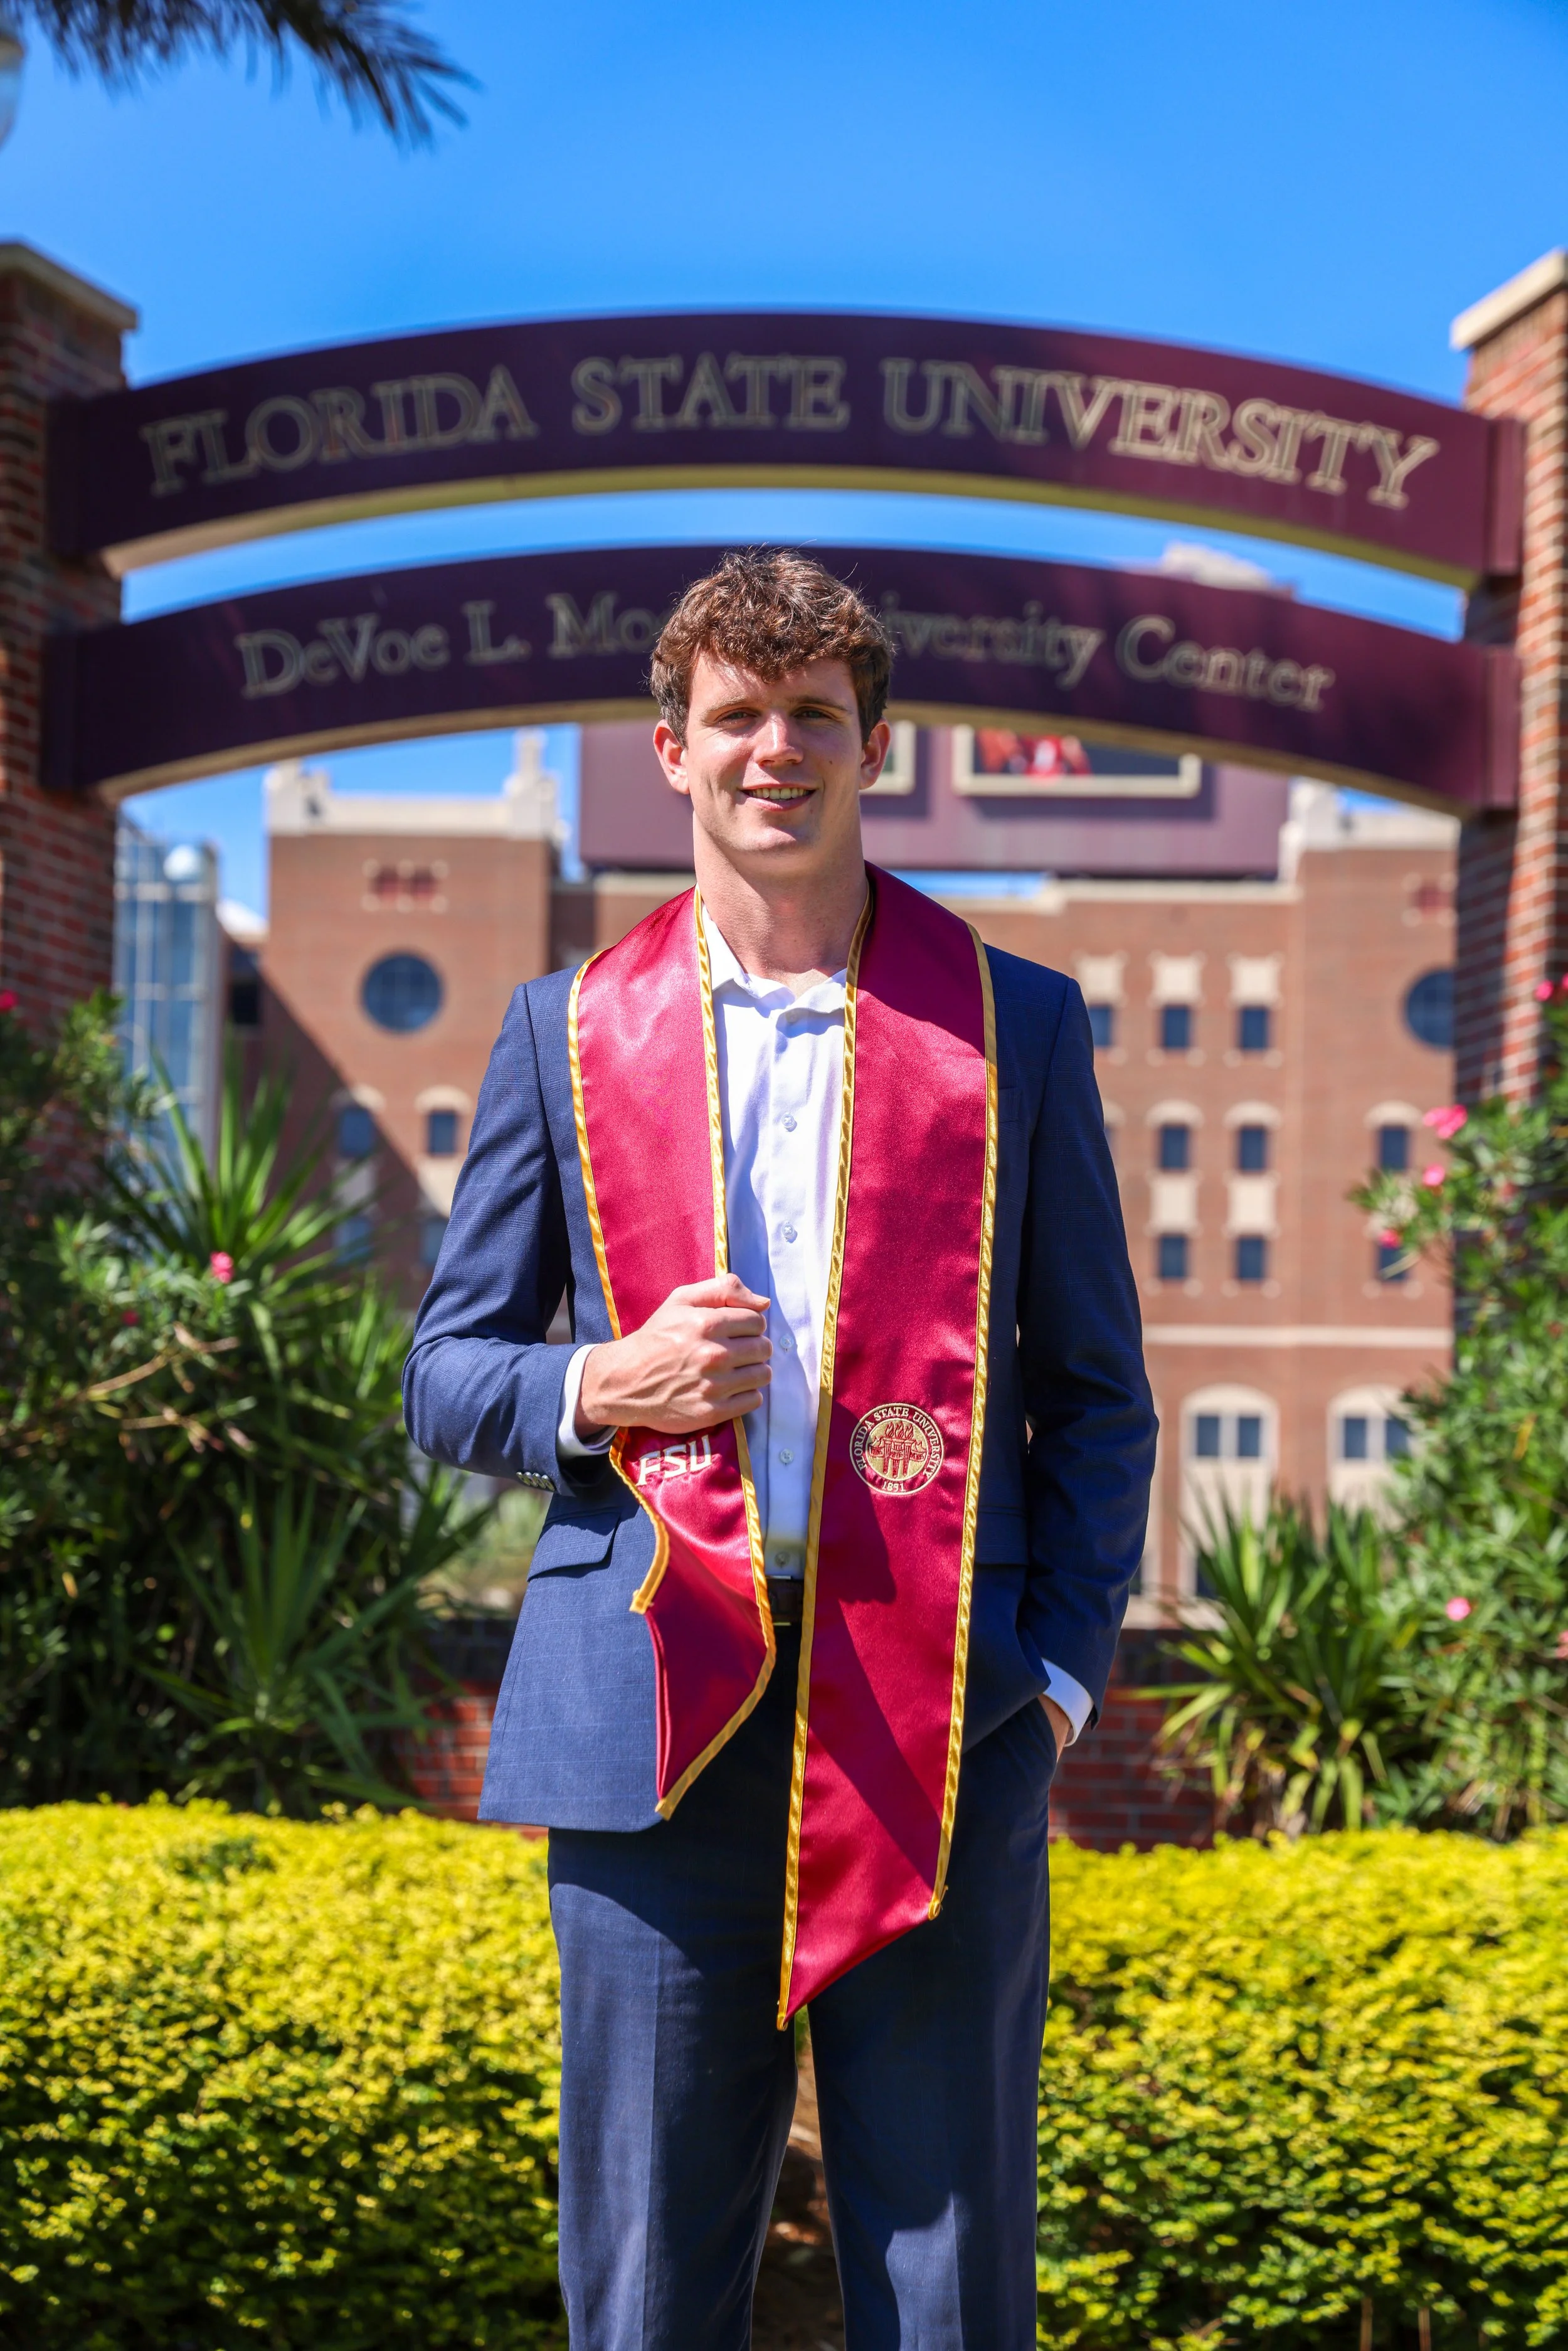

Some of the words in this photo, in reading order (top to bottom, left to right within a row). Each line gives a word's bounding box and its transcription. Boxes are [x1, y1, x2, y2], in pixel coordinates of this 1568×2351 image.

[139, 364, 539, 496] FLORIDA
[571, 353, 850, 435] STATE
[882, 357, 1440, 509] UNIVERSITY
[235, 613, 450, 699] DeVoe
[462, 600, 531, 665] L.
[545, 591, 667, 659] Mo
[879, 590, 1105, 689] iversity
[1116, 614, 1335, 712] Center
[635, 1434, 712, 1487] FSU
[854, 1420, 875, 1471] FLORIDA
[873, 1406, 910, 1421] STATE
[912, 1411, 941, 1481] UNIVERSITY
[881, 1481, 906, 1493] 1851
